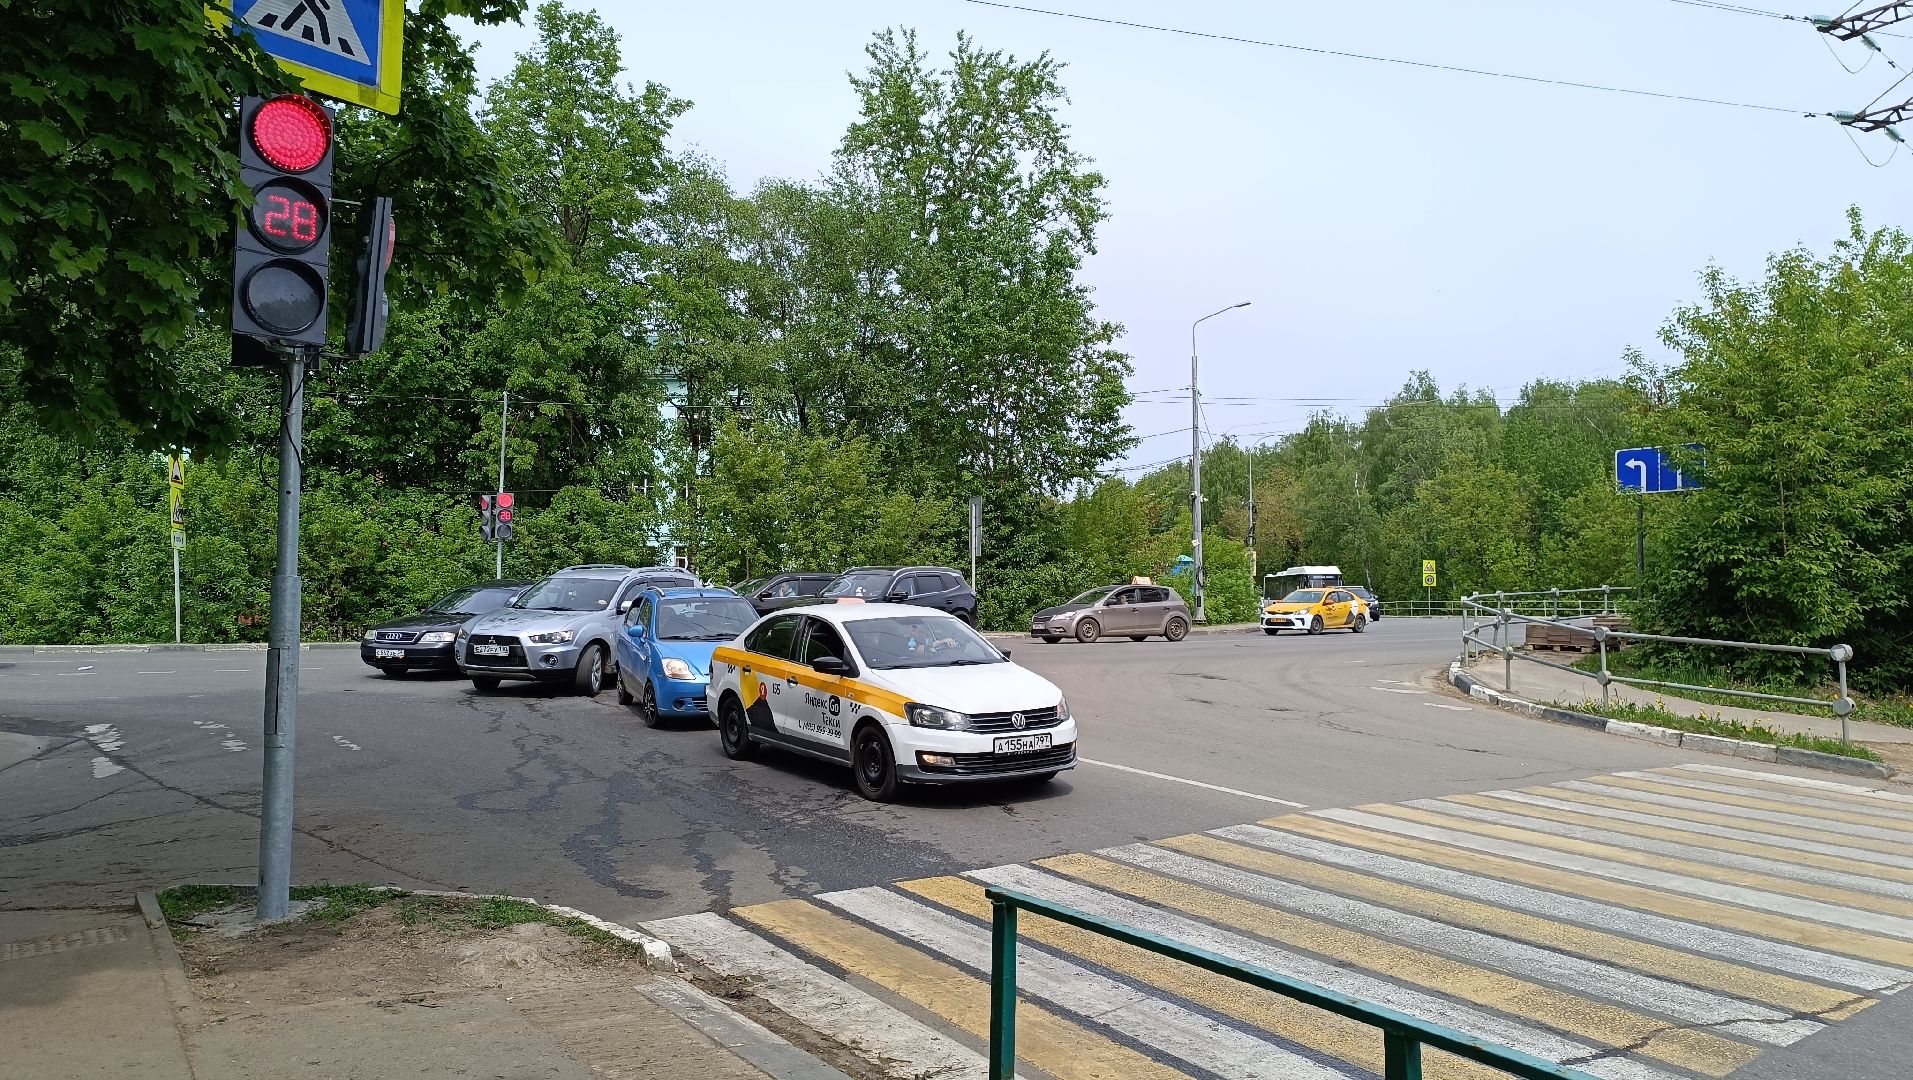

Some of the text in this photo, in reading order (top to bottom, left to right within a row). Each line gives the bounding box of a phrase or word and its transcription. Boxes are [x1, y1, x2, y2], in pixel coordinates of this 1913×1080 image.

[264, 194, 317, 241] 28
[500, 511, 511, 520] 28
[804, 692, 840, 714] Яндекс Go
[821, 711, 841, 729] Такси
[997, 735, 1049, 752] А155НА 797
